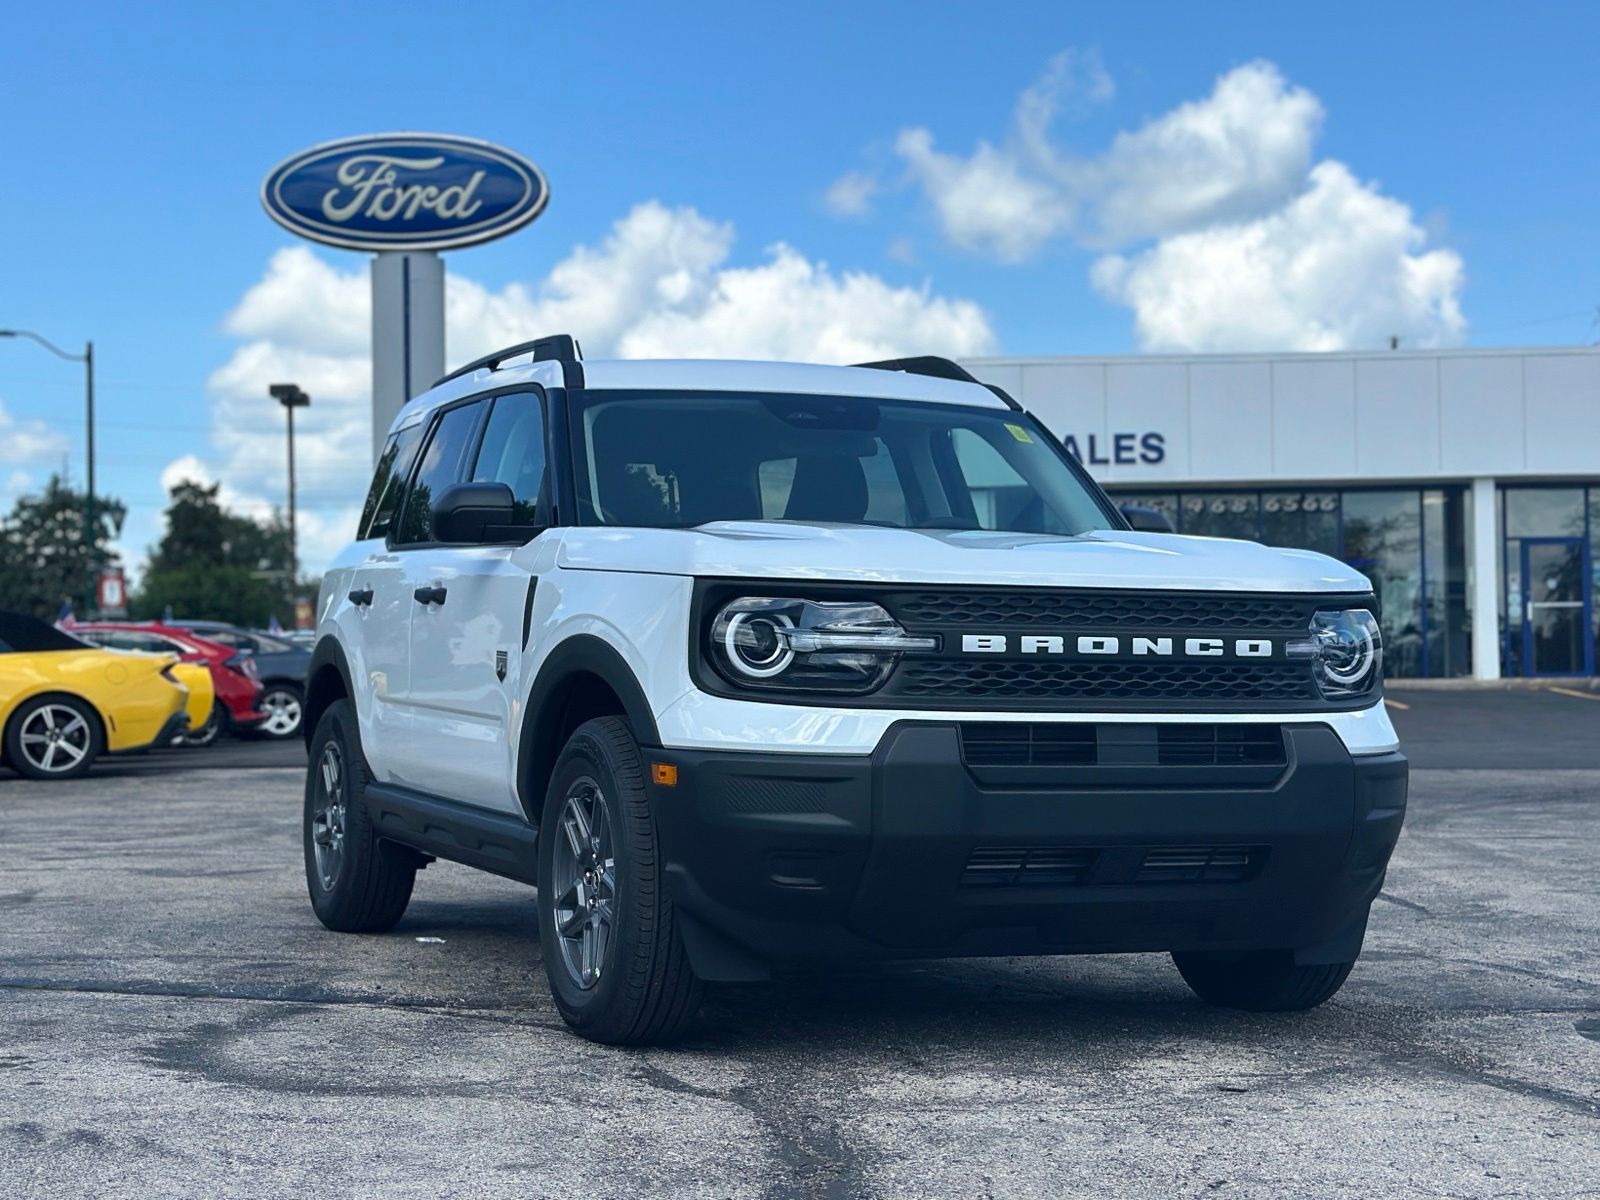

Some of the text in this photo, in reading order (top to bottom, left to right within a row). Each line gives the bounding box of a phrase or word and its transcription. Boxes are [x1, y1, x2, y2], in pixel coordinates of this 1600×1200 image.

[322, 154, 486, 222] Ford
[1264, 496, 1337, 513] 6566
[962, 634, 1272, 657] BRONCO
